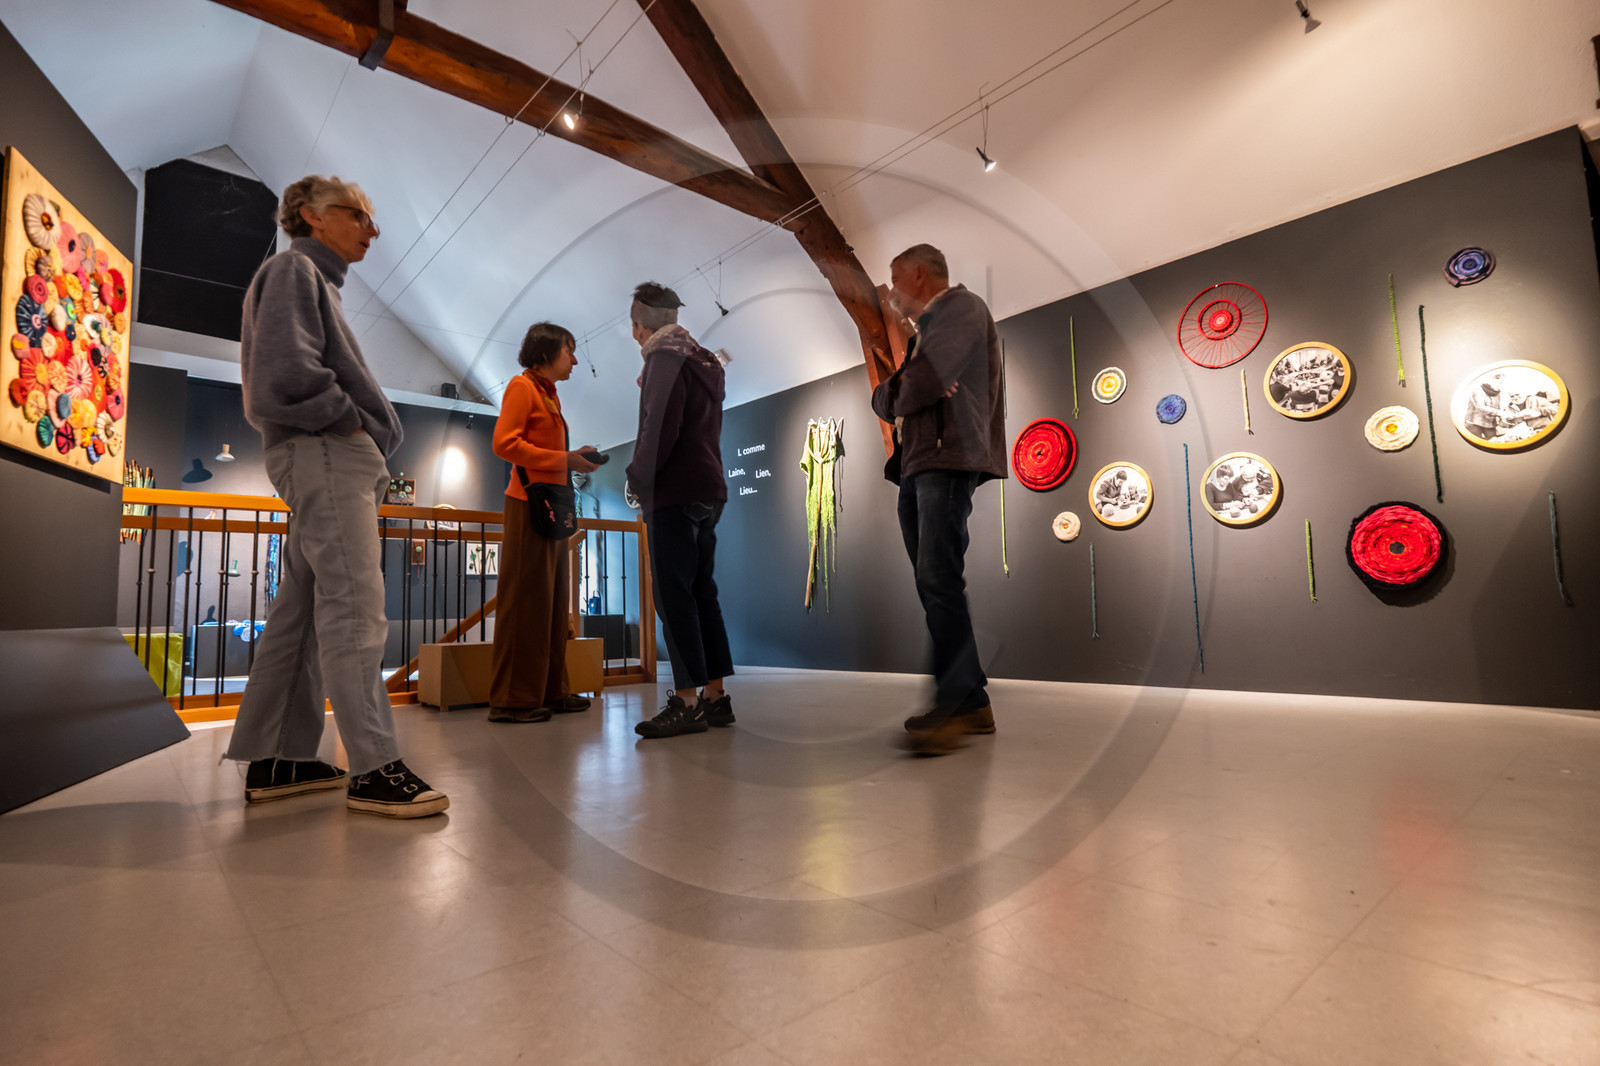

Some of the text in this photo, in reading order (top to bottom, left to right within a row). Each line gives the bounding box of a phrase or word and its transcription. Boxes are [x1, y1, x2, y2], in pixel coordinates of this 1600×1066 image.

[737, 443, 766, 457] L comme
[728, 467, 772, 479] Laine, Lien,
